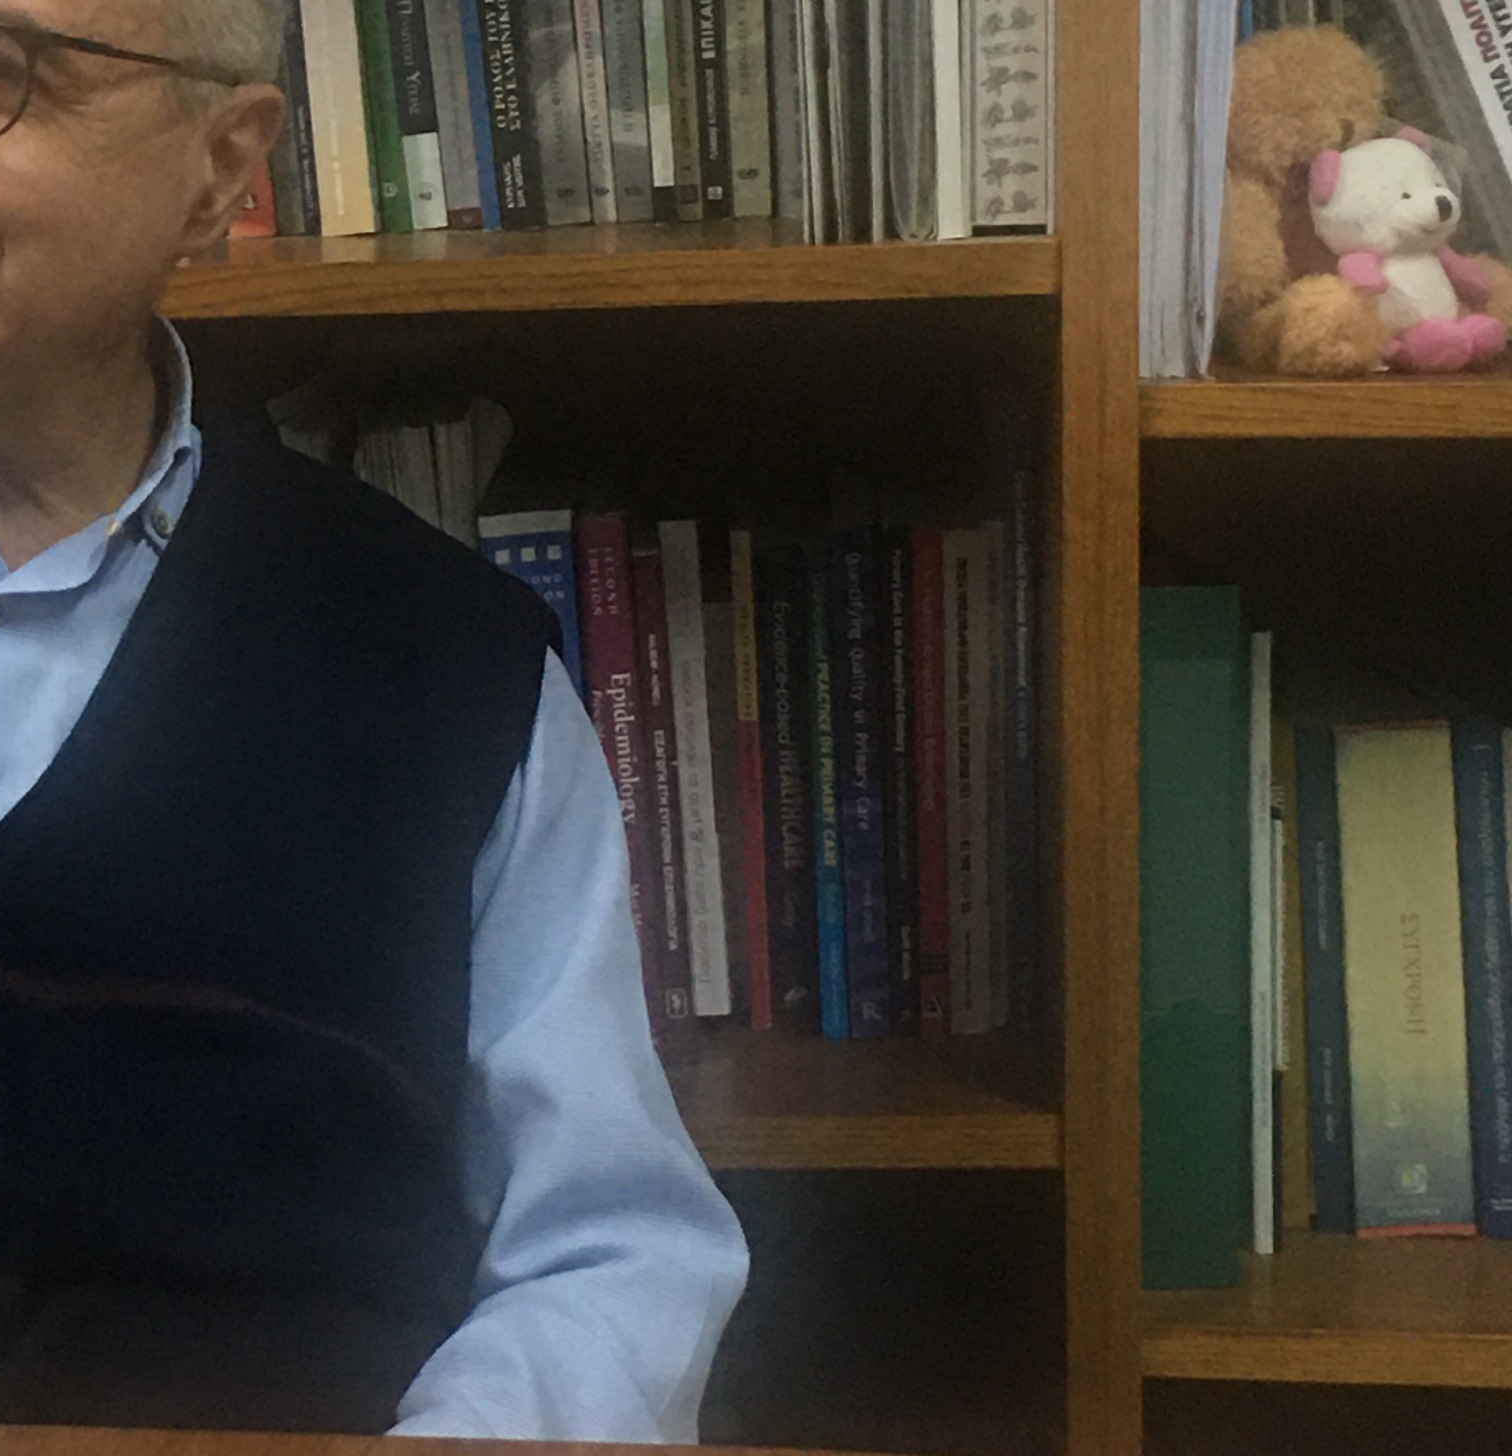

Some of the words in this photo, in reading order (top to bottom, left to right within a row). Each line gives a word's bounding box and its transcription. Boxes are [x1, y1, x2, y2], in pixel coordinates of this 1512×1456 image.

[485, 9, 499, 42] ΤΟΥ
[489, 49, 506, 110] ΡΟΛΟΣ
[495, 115, 508, 129] Ο
[507, 94, 522, 132] ΣΤΟ
[588, 547, 603, 617] EDITION
[604, 547, 618, 616] SECOND
[845, 552, 864, 641] Quantifying
[773, 600, 794, 744] Evidence-based
[816, 661, 832, 732] PRACTICE
[849, 647, 866, 702] Quality
[819, 735, 833, 754] IN
[854, 709, 866, 726] in
[608, 672, 640, 824] Epidemiology
[654, 730, 668, 782] ΕΙΣΑΓΩΓΗ
[853, 732, 870, 790] Primary
[778, 749, 806, 870] HEALTHCARE
[820, 757, 835, 824] PRIMARY
[856, 796, 872, 832] Care
[823, 828, 838, 867] CARE
[1400, 912, 1427, 1035] ΣΥΓΧΡΟΝΗ
